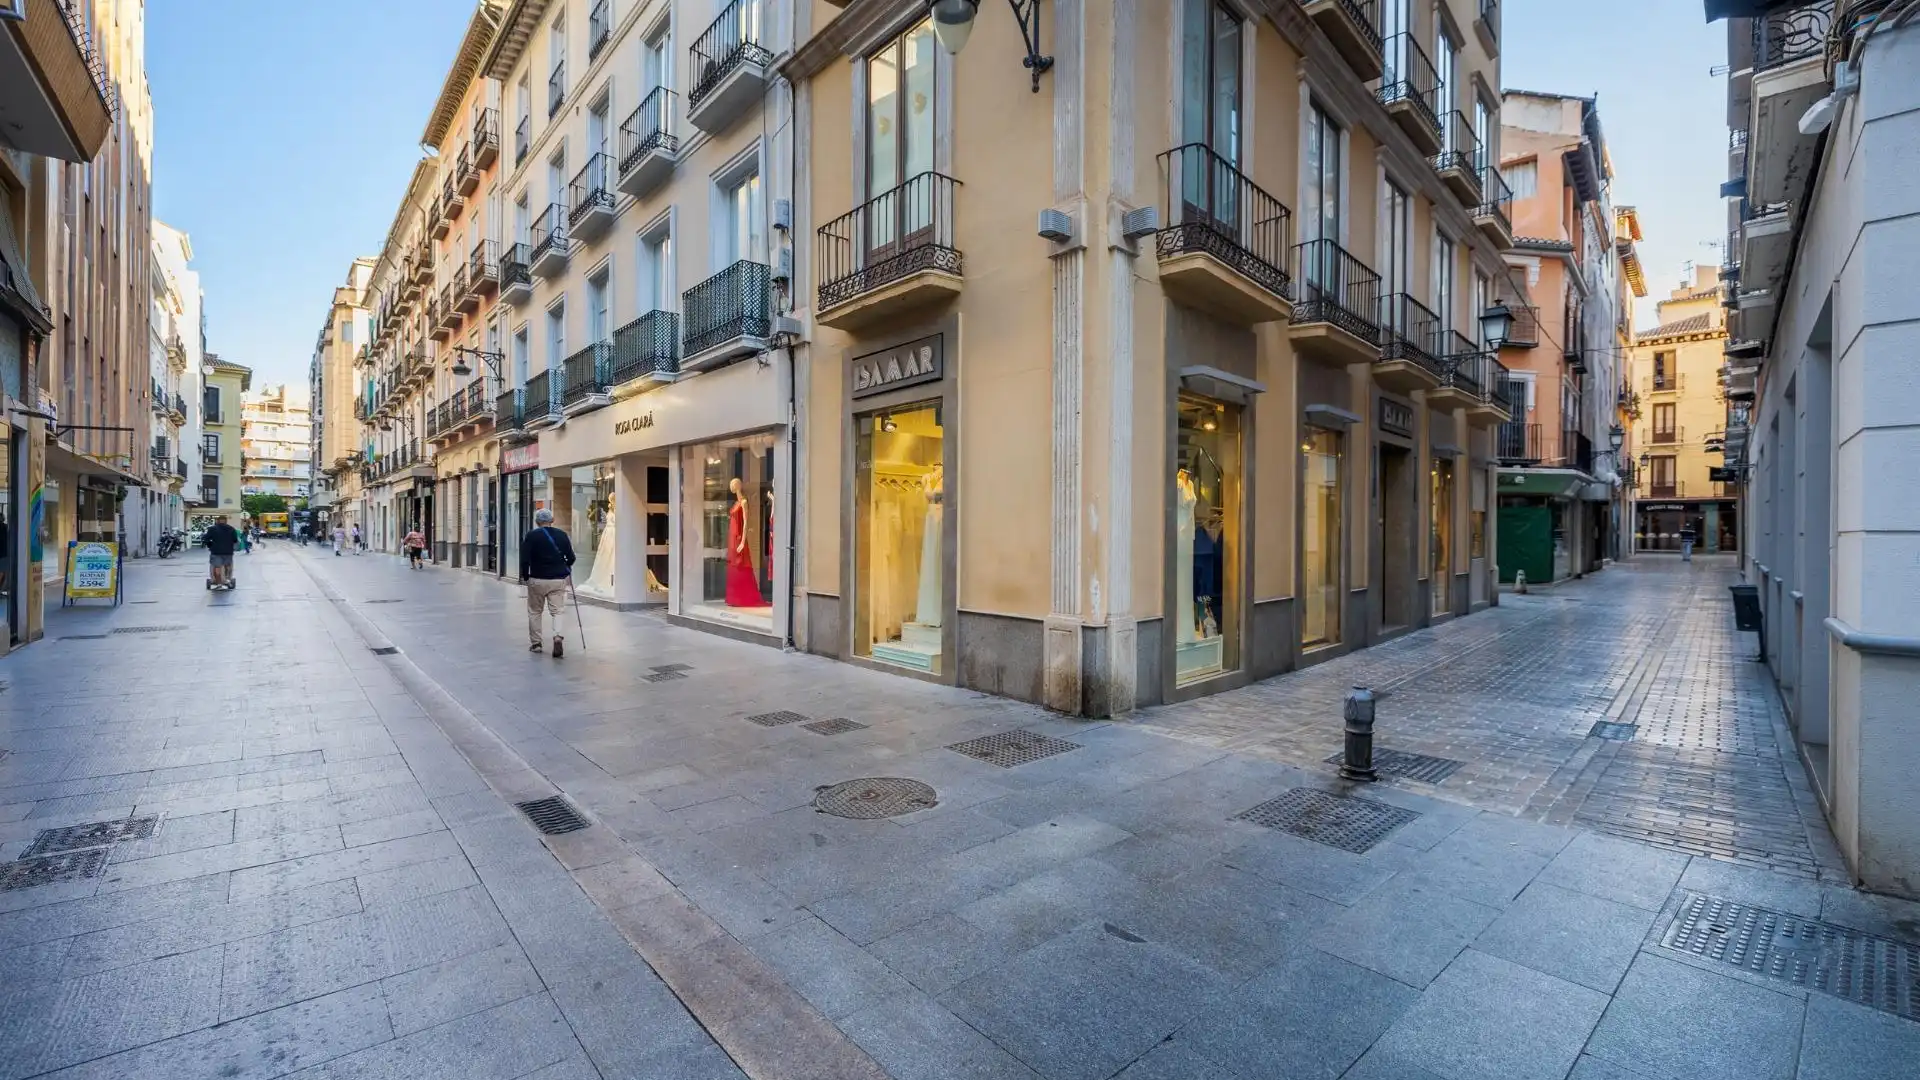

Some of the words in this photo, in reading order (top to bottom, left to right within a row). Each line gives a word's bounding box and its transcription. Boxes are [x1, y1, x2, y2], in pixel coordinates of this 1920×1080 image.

[615, 420, 631, 435] ROSA
[632, 410, 654, 431] CLARÁ
[87, 563, 111, 571] 99€
[79, 580, 105, 588] 259€
